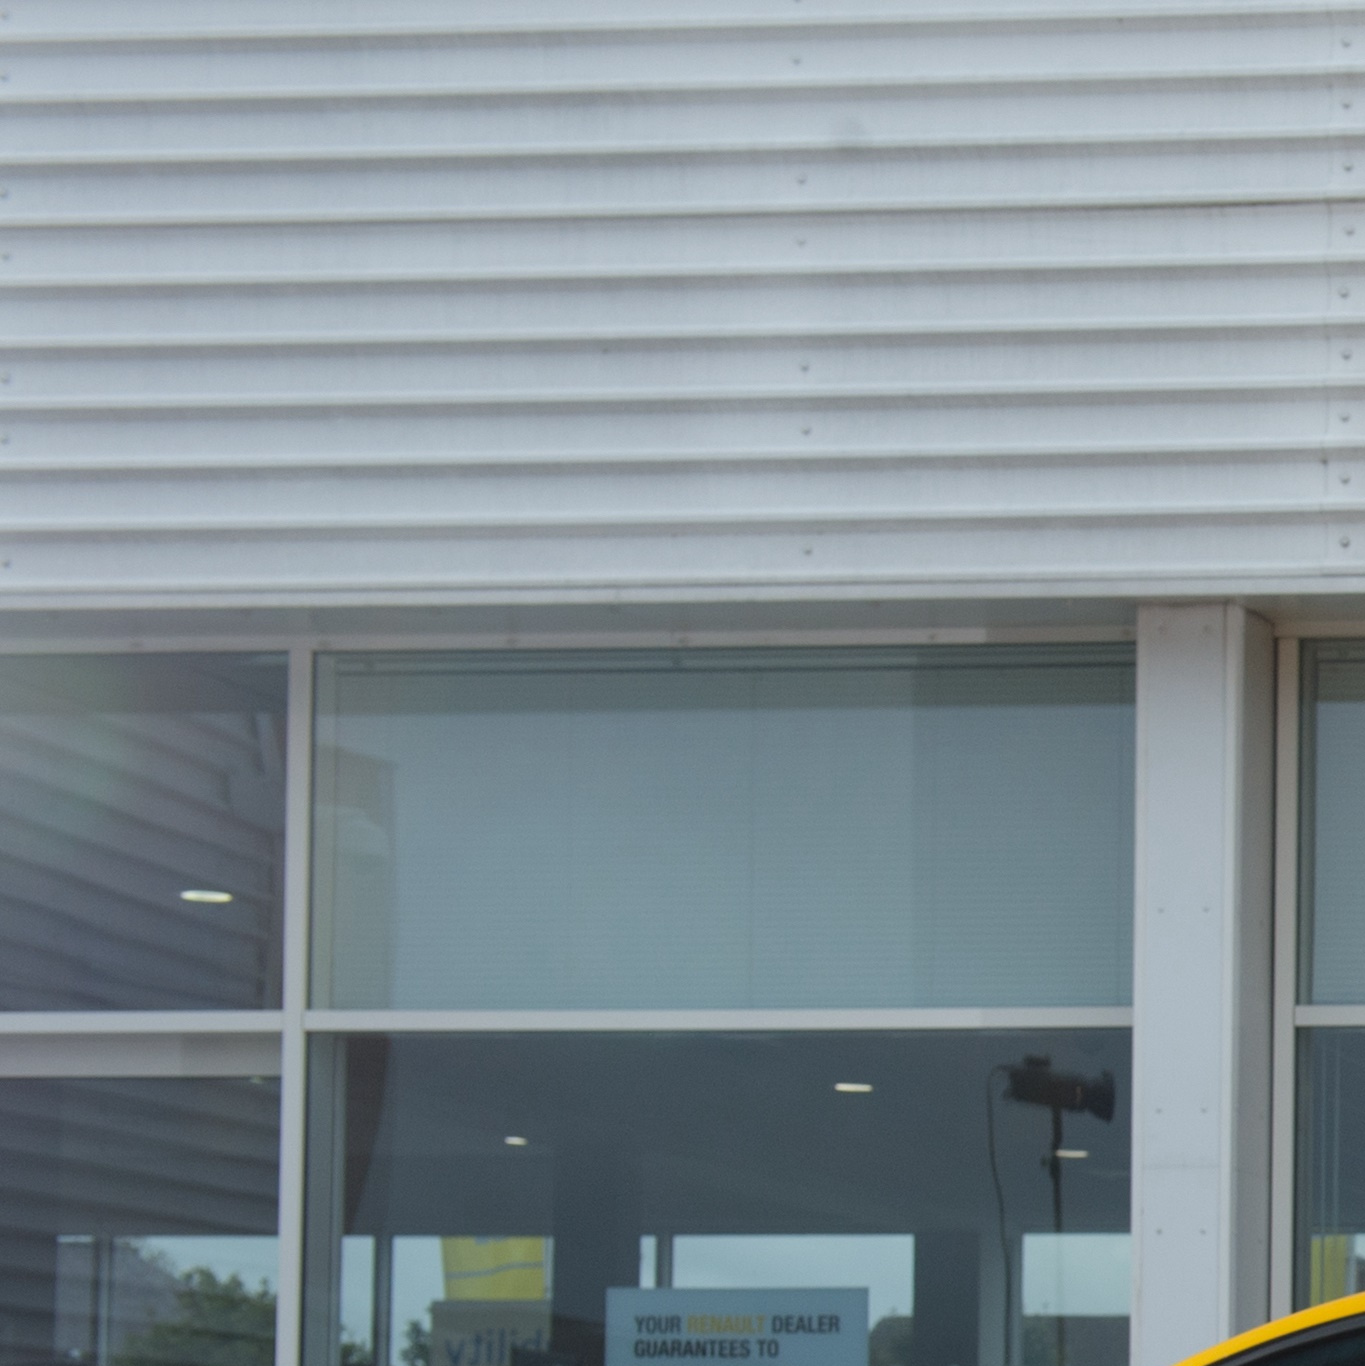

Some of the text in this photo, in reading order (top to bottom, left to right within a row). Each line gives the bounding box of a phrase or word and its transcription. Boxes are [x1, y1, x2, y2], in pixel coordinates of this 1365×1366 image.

[634, 1314, 841, 1335] YOUR RENAULT DEALER
[634, 1339, 780, 1358] GUARANTEES TO
